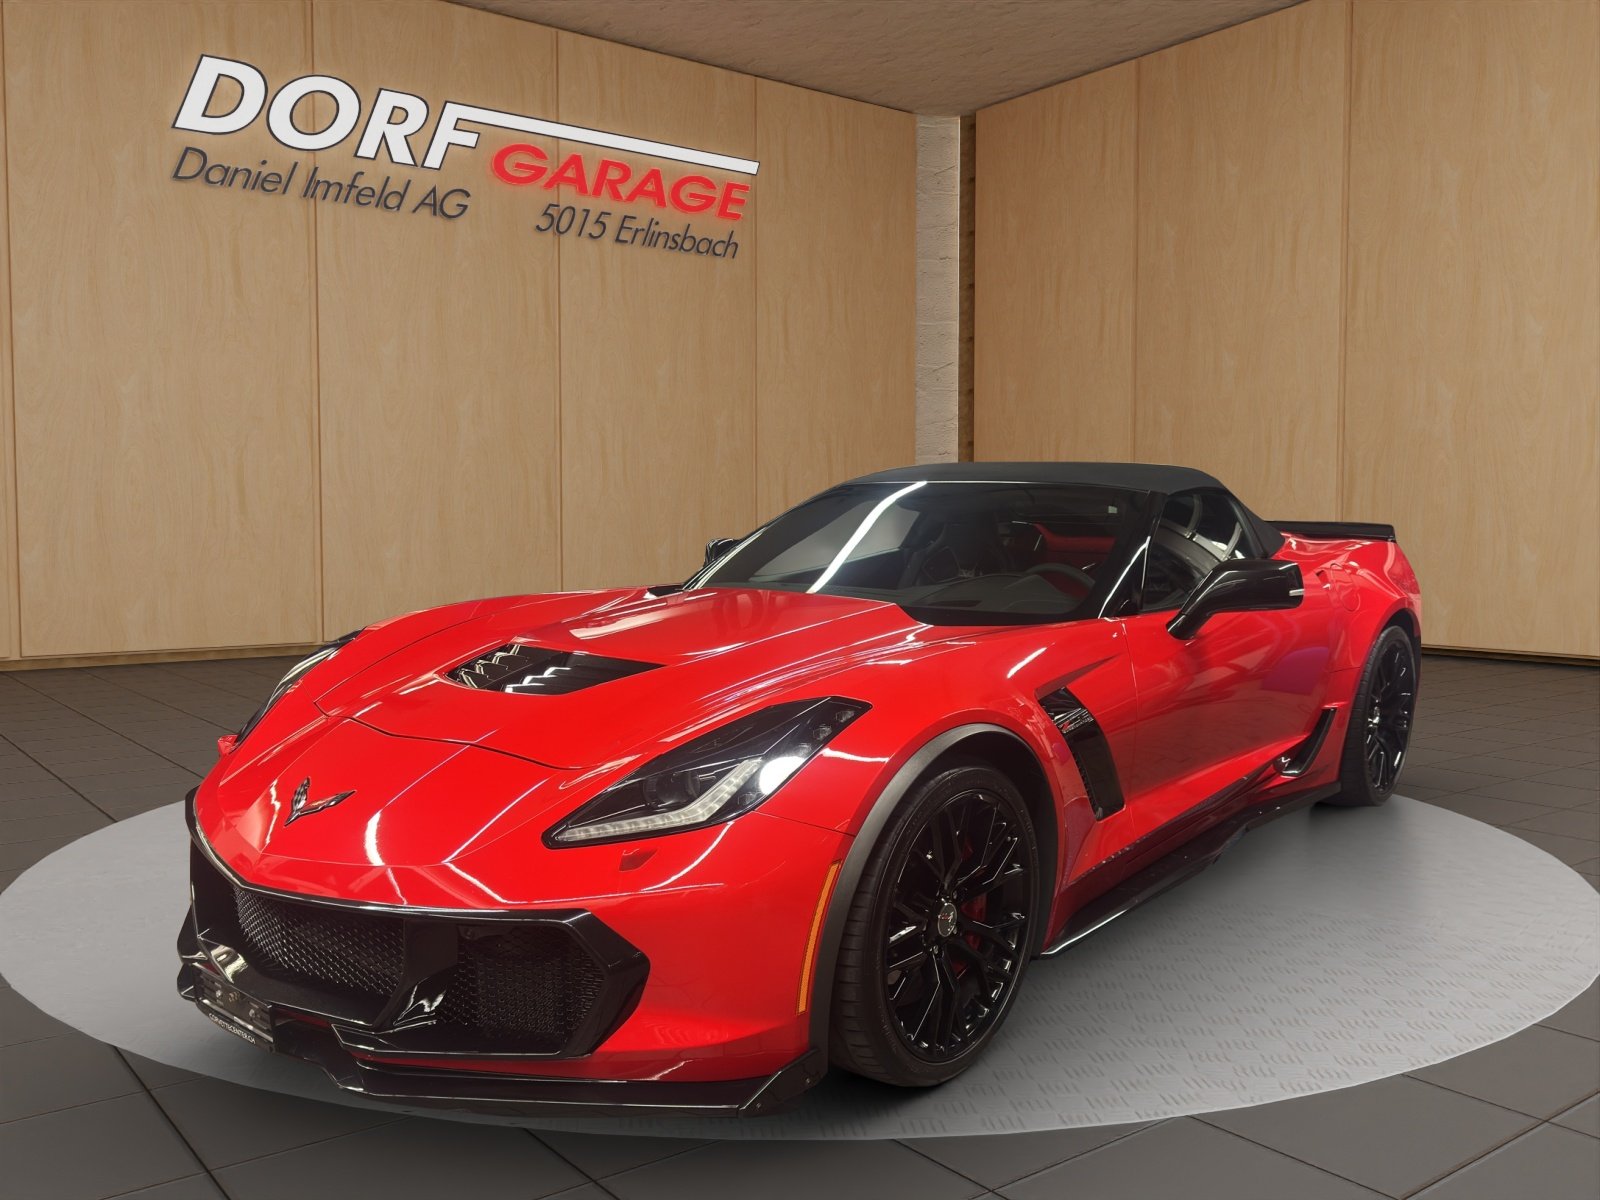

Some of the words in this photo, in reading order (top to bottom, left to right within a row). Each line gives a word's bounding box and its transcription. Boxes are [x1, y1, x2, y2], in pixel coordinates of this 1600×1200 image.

[171, 54, 481, 170] DORF
[172, 146, 298, 195] Daniel
[302, 166, 411, 211] Imfeld
[411, 184, 472, 219] AG
[491, 143, 751, 221] GARAGE
[535, 203, 611, 239] 5015
[614, 214, 739, 259] Erlinsbach
